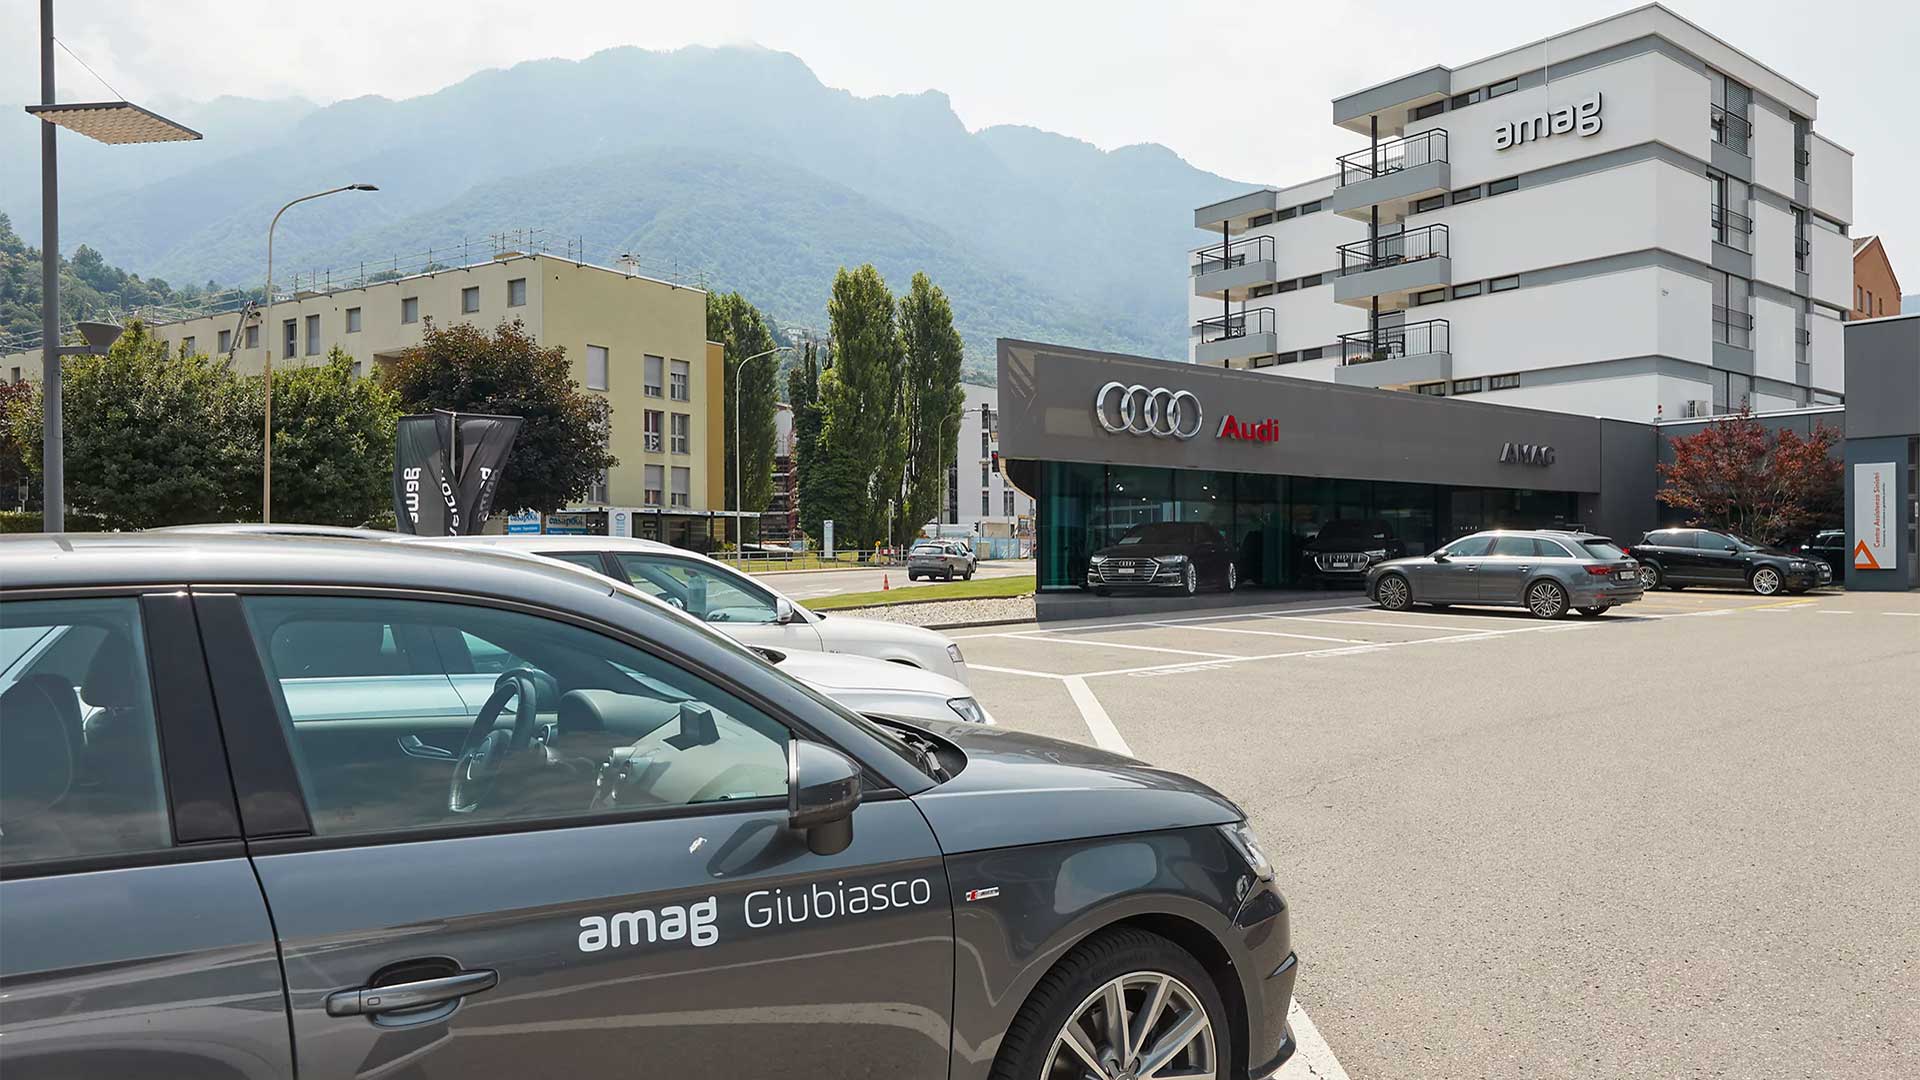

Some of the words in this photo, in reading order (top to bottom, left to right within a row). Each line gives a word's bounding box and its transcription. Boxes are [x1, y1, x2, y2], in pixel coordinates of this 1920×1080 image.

[1495, 90, 1602, 151] amag
[1217, 414, 1279, 442] Audi
[1500, 442, 1556, 466] AMAG
[578, 896, 718, 952] amag
[744, 878, 931, 928] Giubiasco
